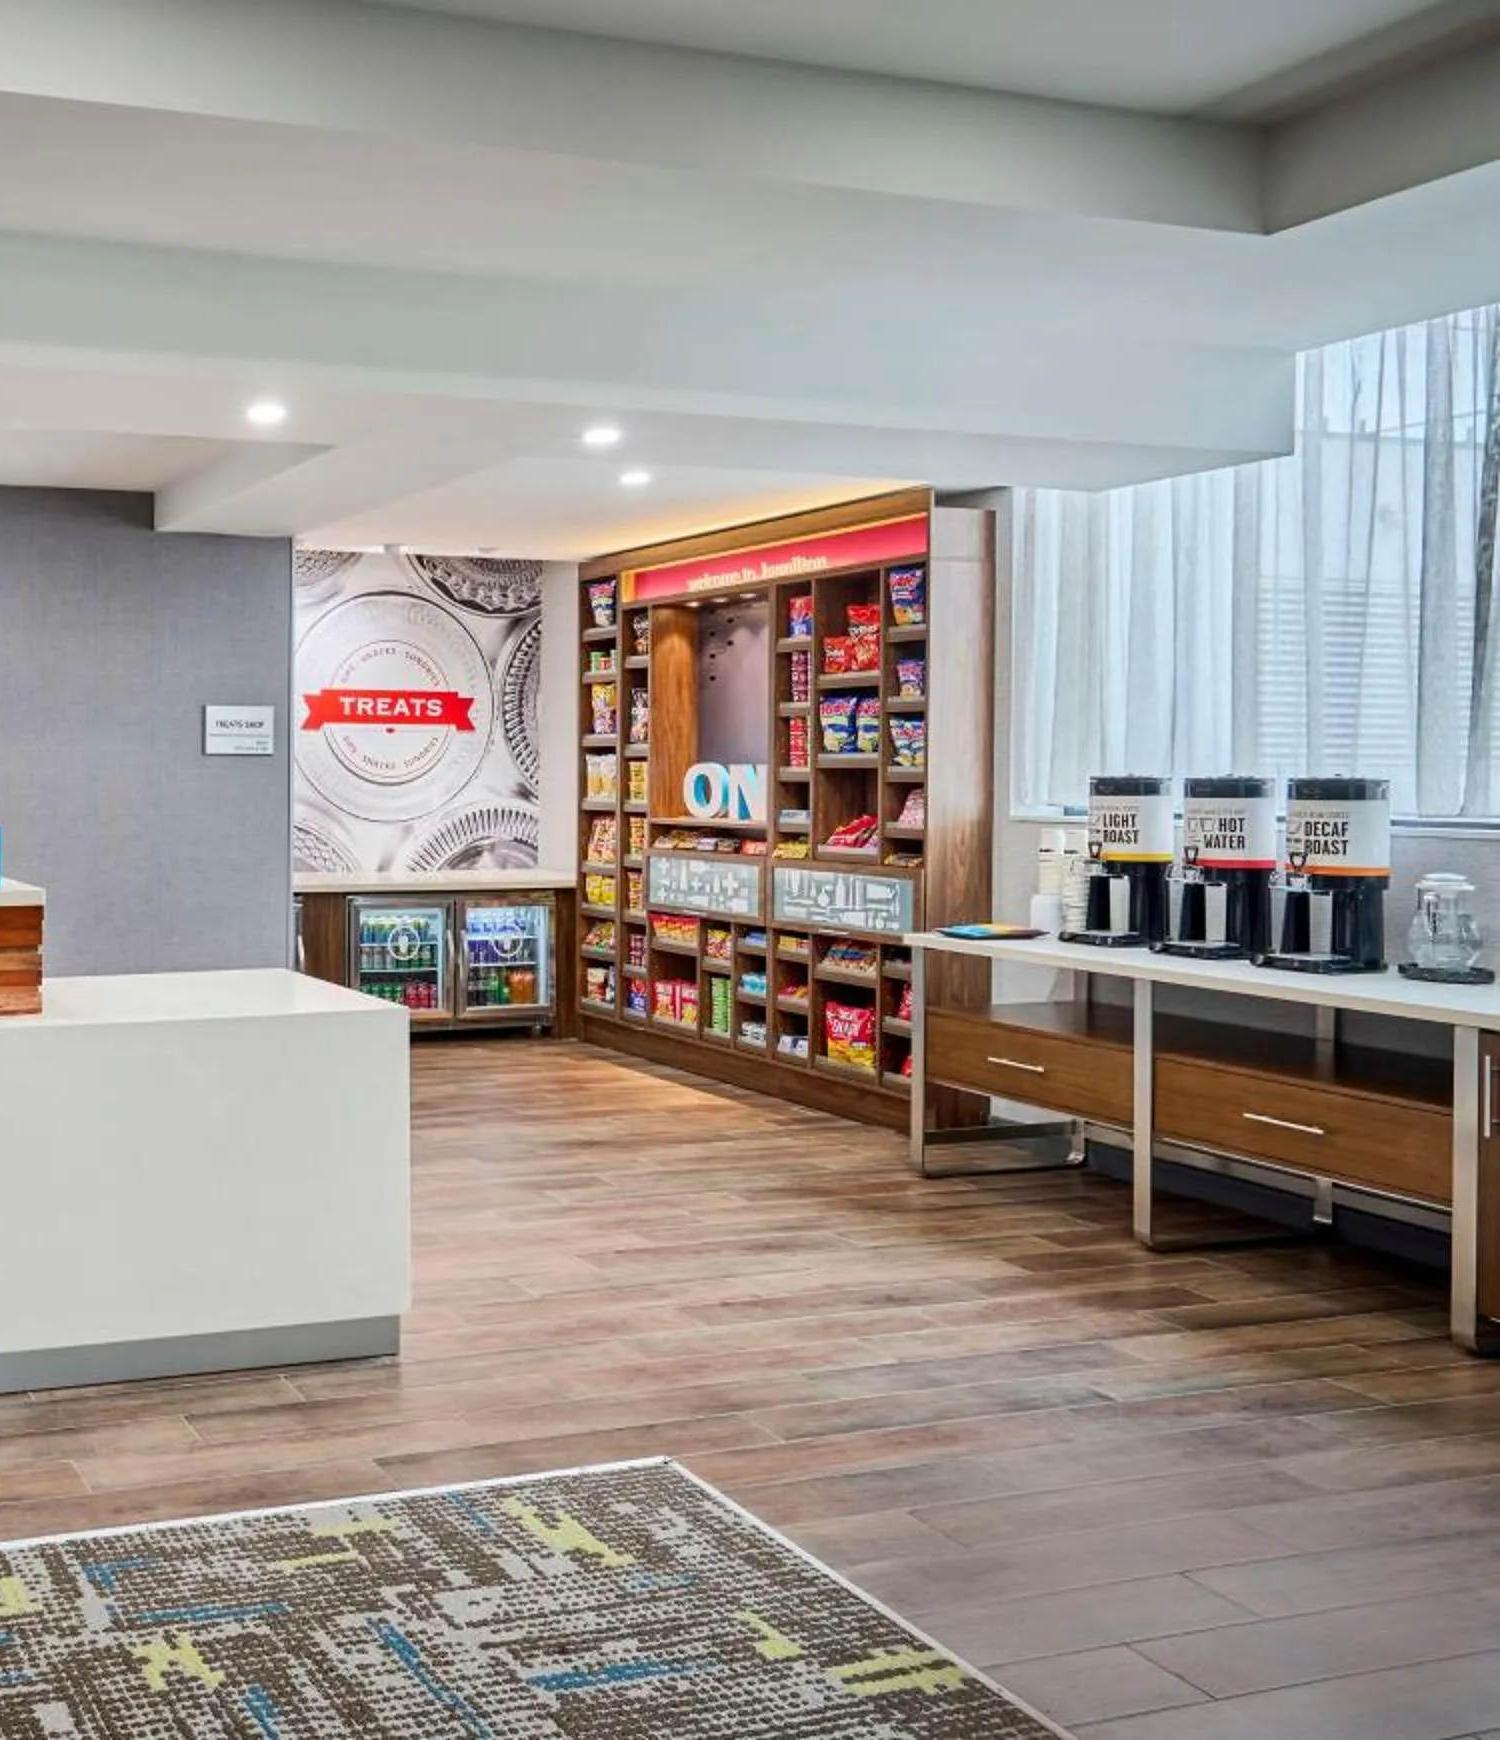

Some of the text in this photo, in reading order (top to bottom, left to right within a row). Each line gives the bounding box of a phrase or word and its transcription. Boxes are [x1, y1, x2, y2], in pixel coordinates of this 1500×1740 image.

[339, 696, 444, 718] TREATS
[683, 762, 768, 822] ON
[1103, 813, 1138, 828] LIGHT
[1219, 817, 1245, 833] HOT
[1103, 829, 1140, 844] ROAST
[1304, 821, 1349, 837] DECAF
[1203, 834, 1245, 849] WATER
[1304, 839, 1349, 855] ROAST
